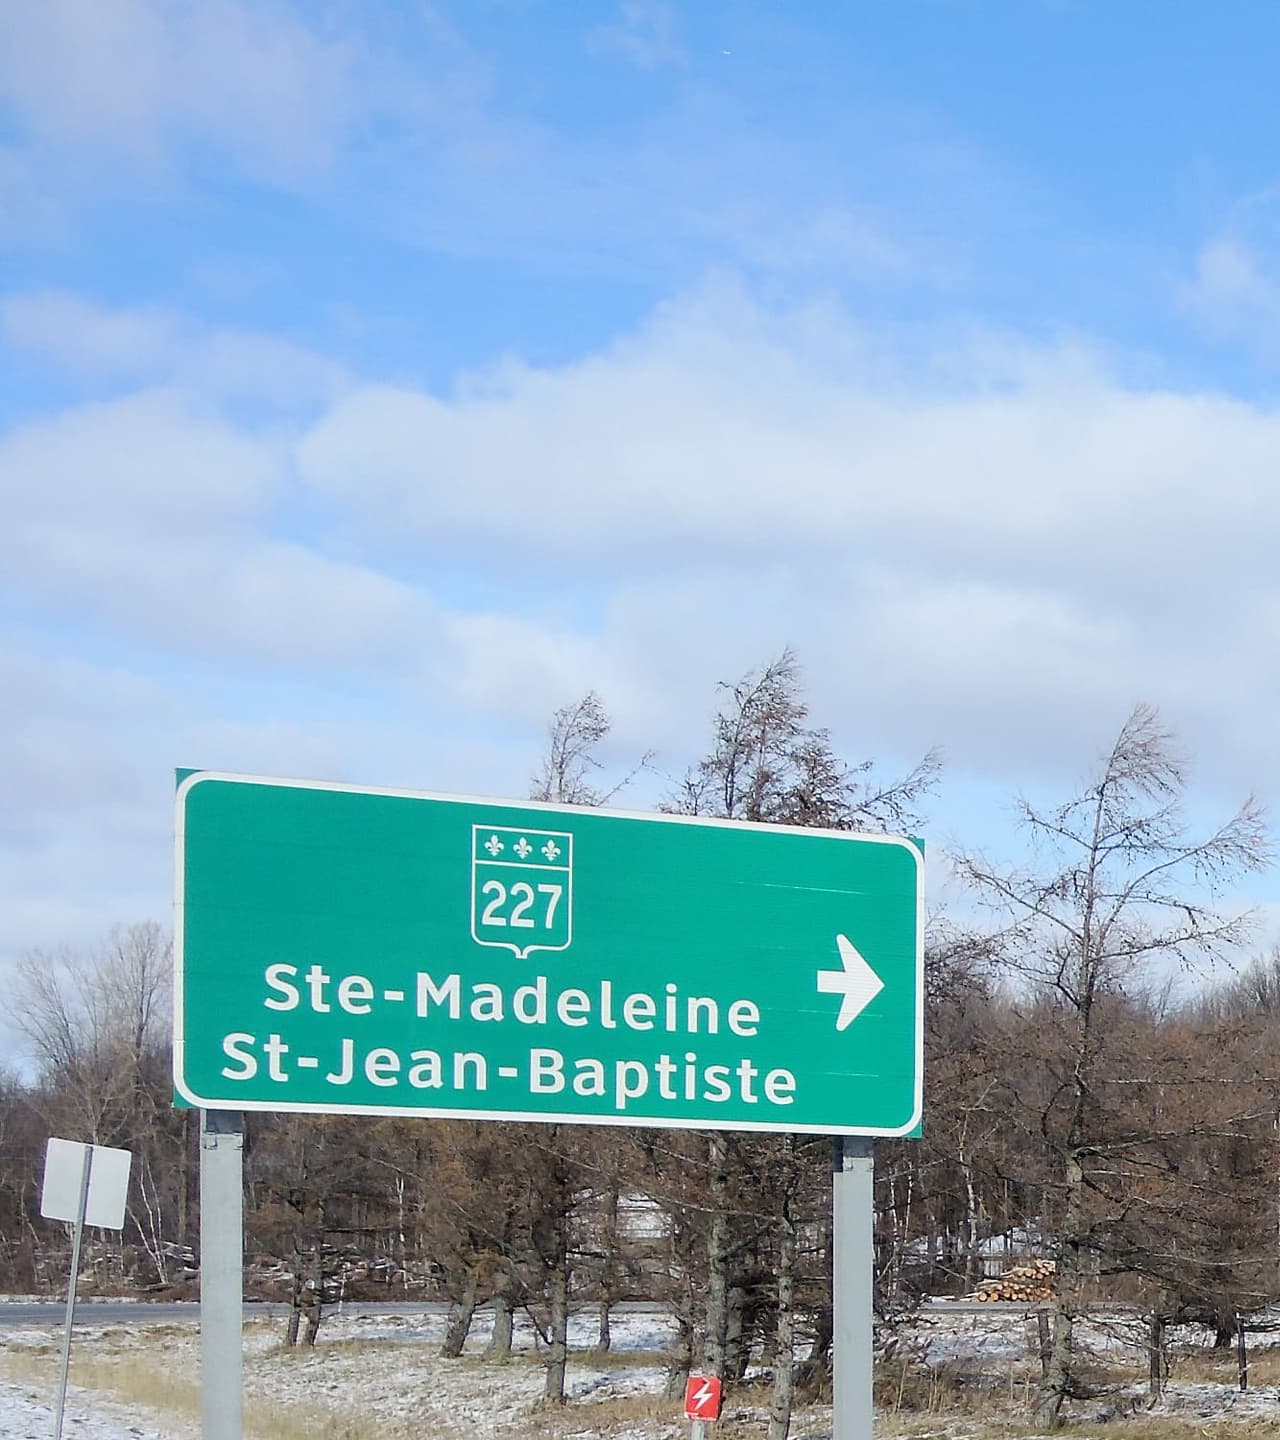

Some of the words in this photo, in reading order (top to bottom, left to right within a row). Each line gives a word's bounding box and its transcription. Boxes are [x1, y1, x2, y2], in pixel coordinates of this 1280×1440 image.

[480, 880, 563, 930] 227
[263, 962, 761, 1037] Ste-Madeleine
[220, 1031, 797, 1110] St-Jean-Baptiste
